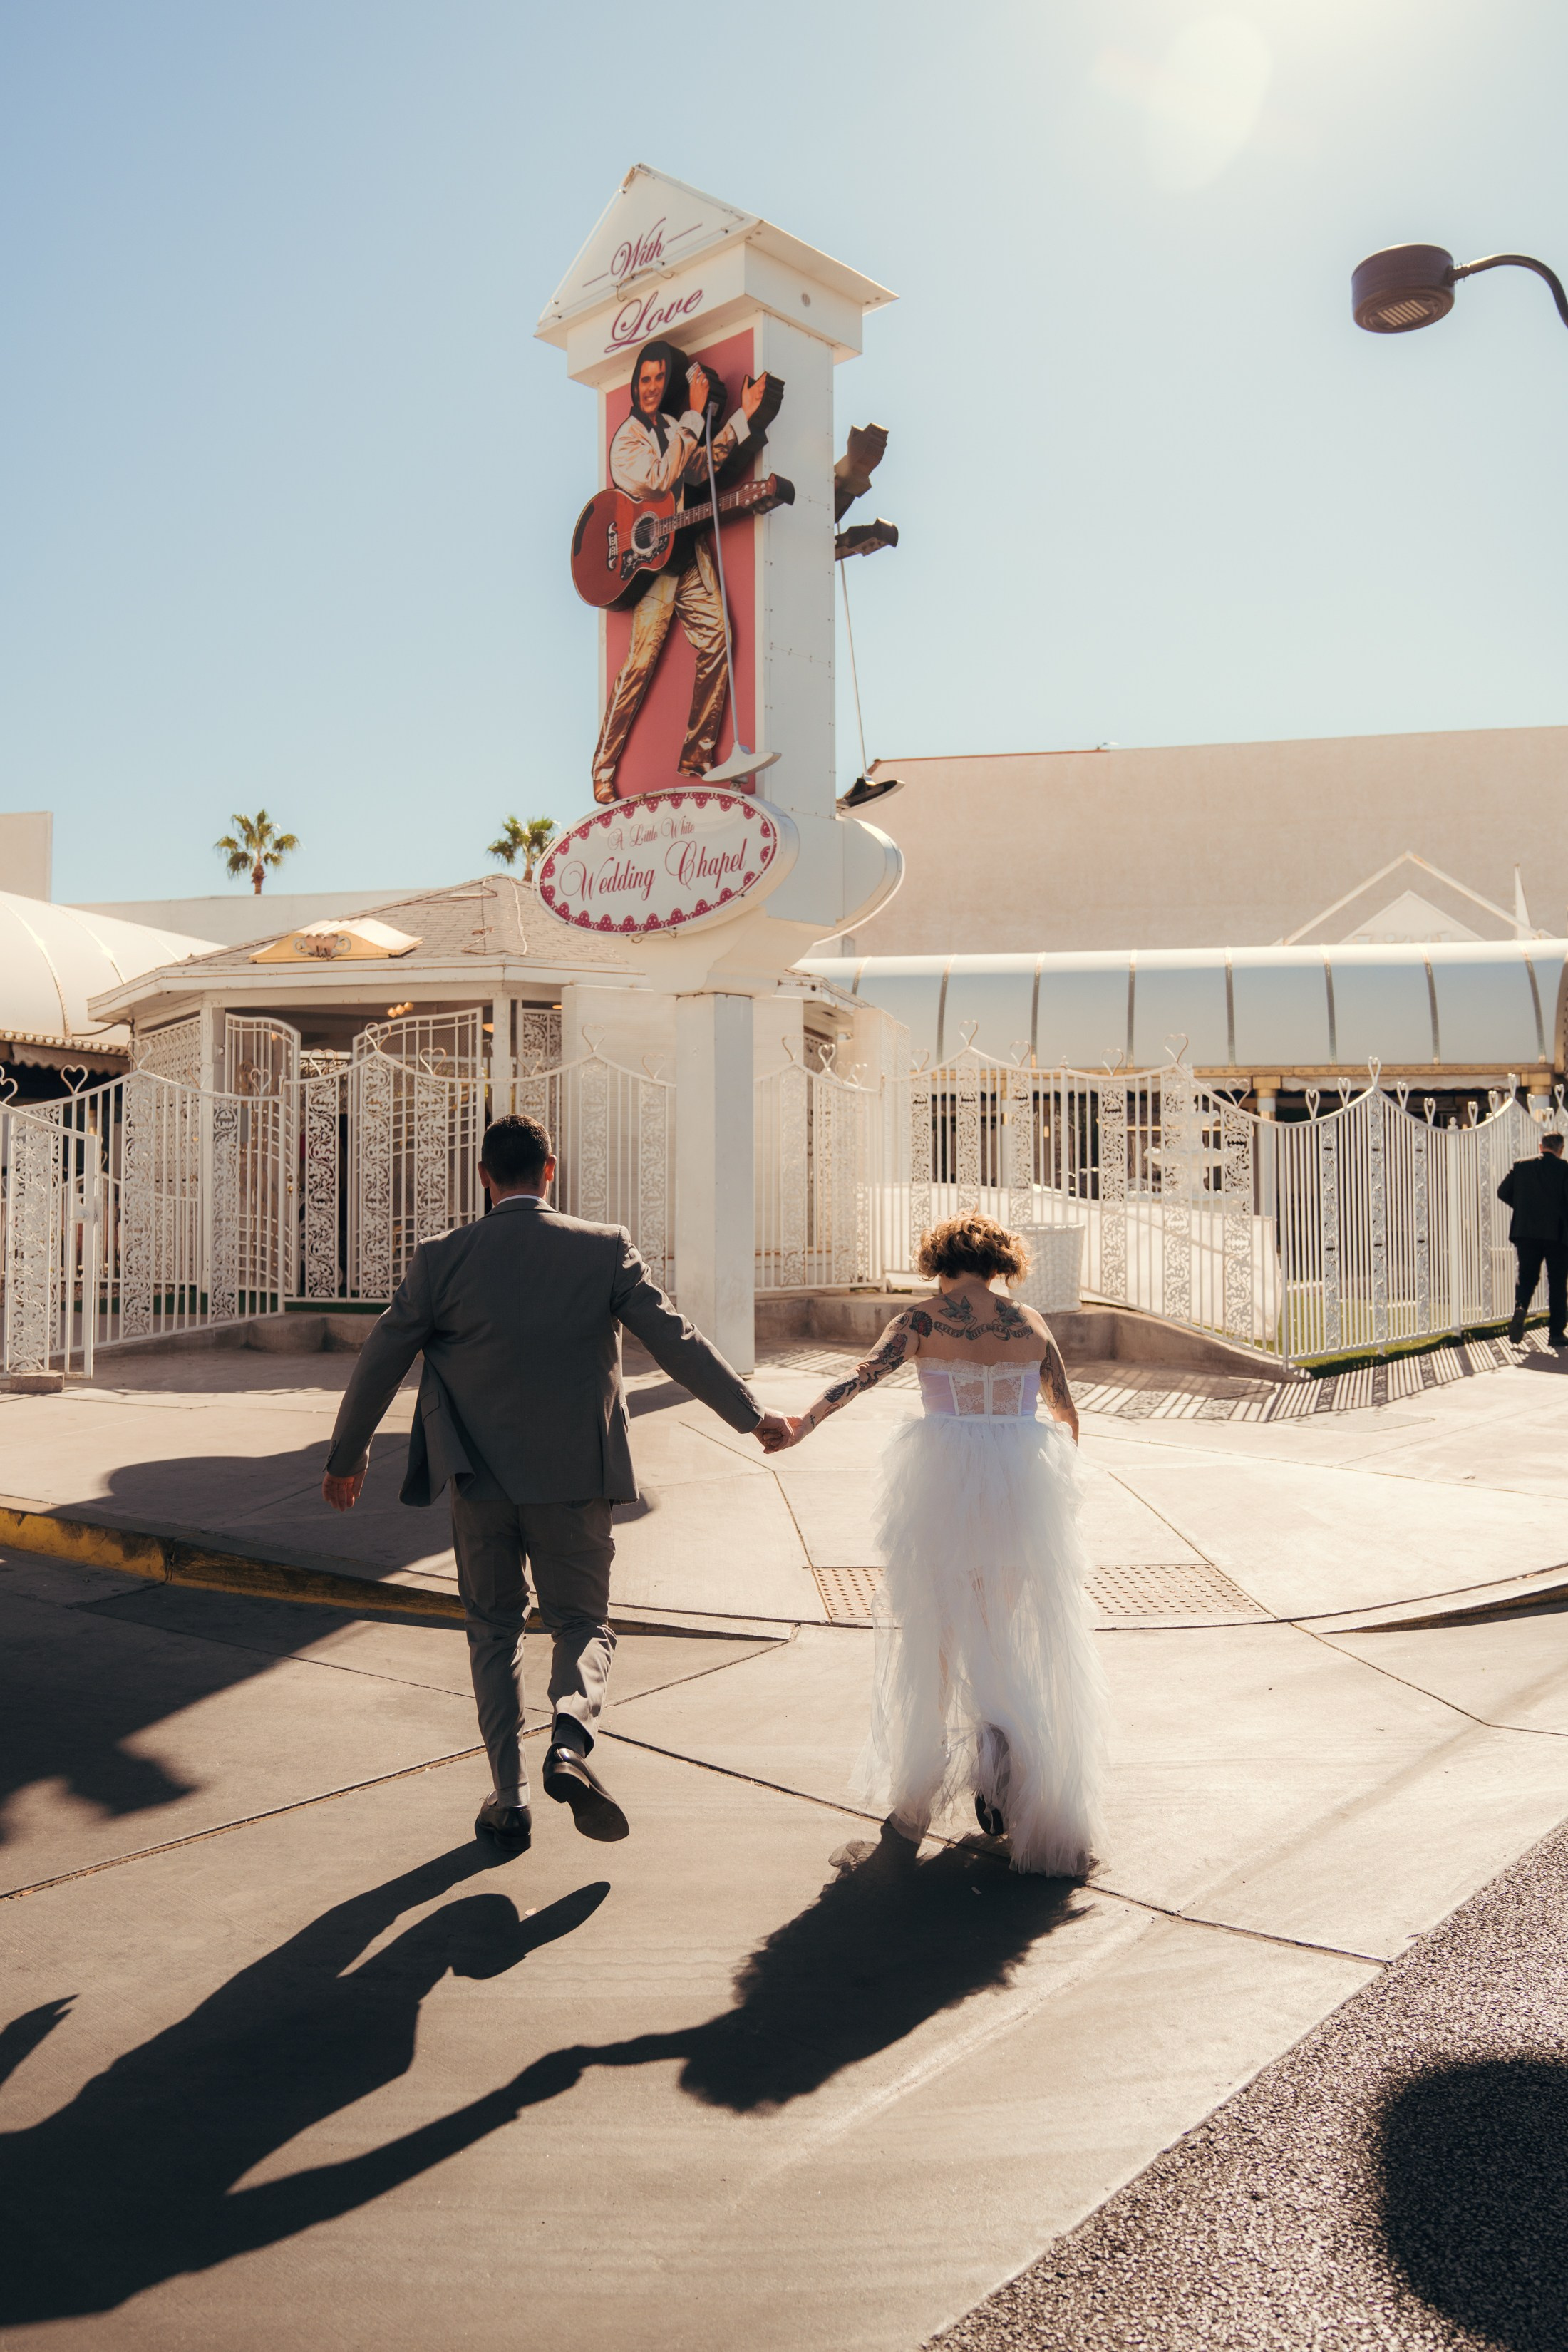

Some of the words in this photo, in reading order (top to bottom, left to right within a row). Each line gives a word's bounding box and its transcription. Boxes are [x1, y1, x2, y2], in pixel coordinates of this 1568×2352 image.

[611, 217, 666, 279] With
[604, 289, 703, 354] Love
[607, 827, 625, 851] A
[630, 822, 658, 847] Little
[661, 815, 695, 840] White
[559, 857, 656, 902] Wedding
[665, 838, 748, 891] Chapel
